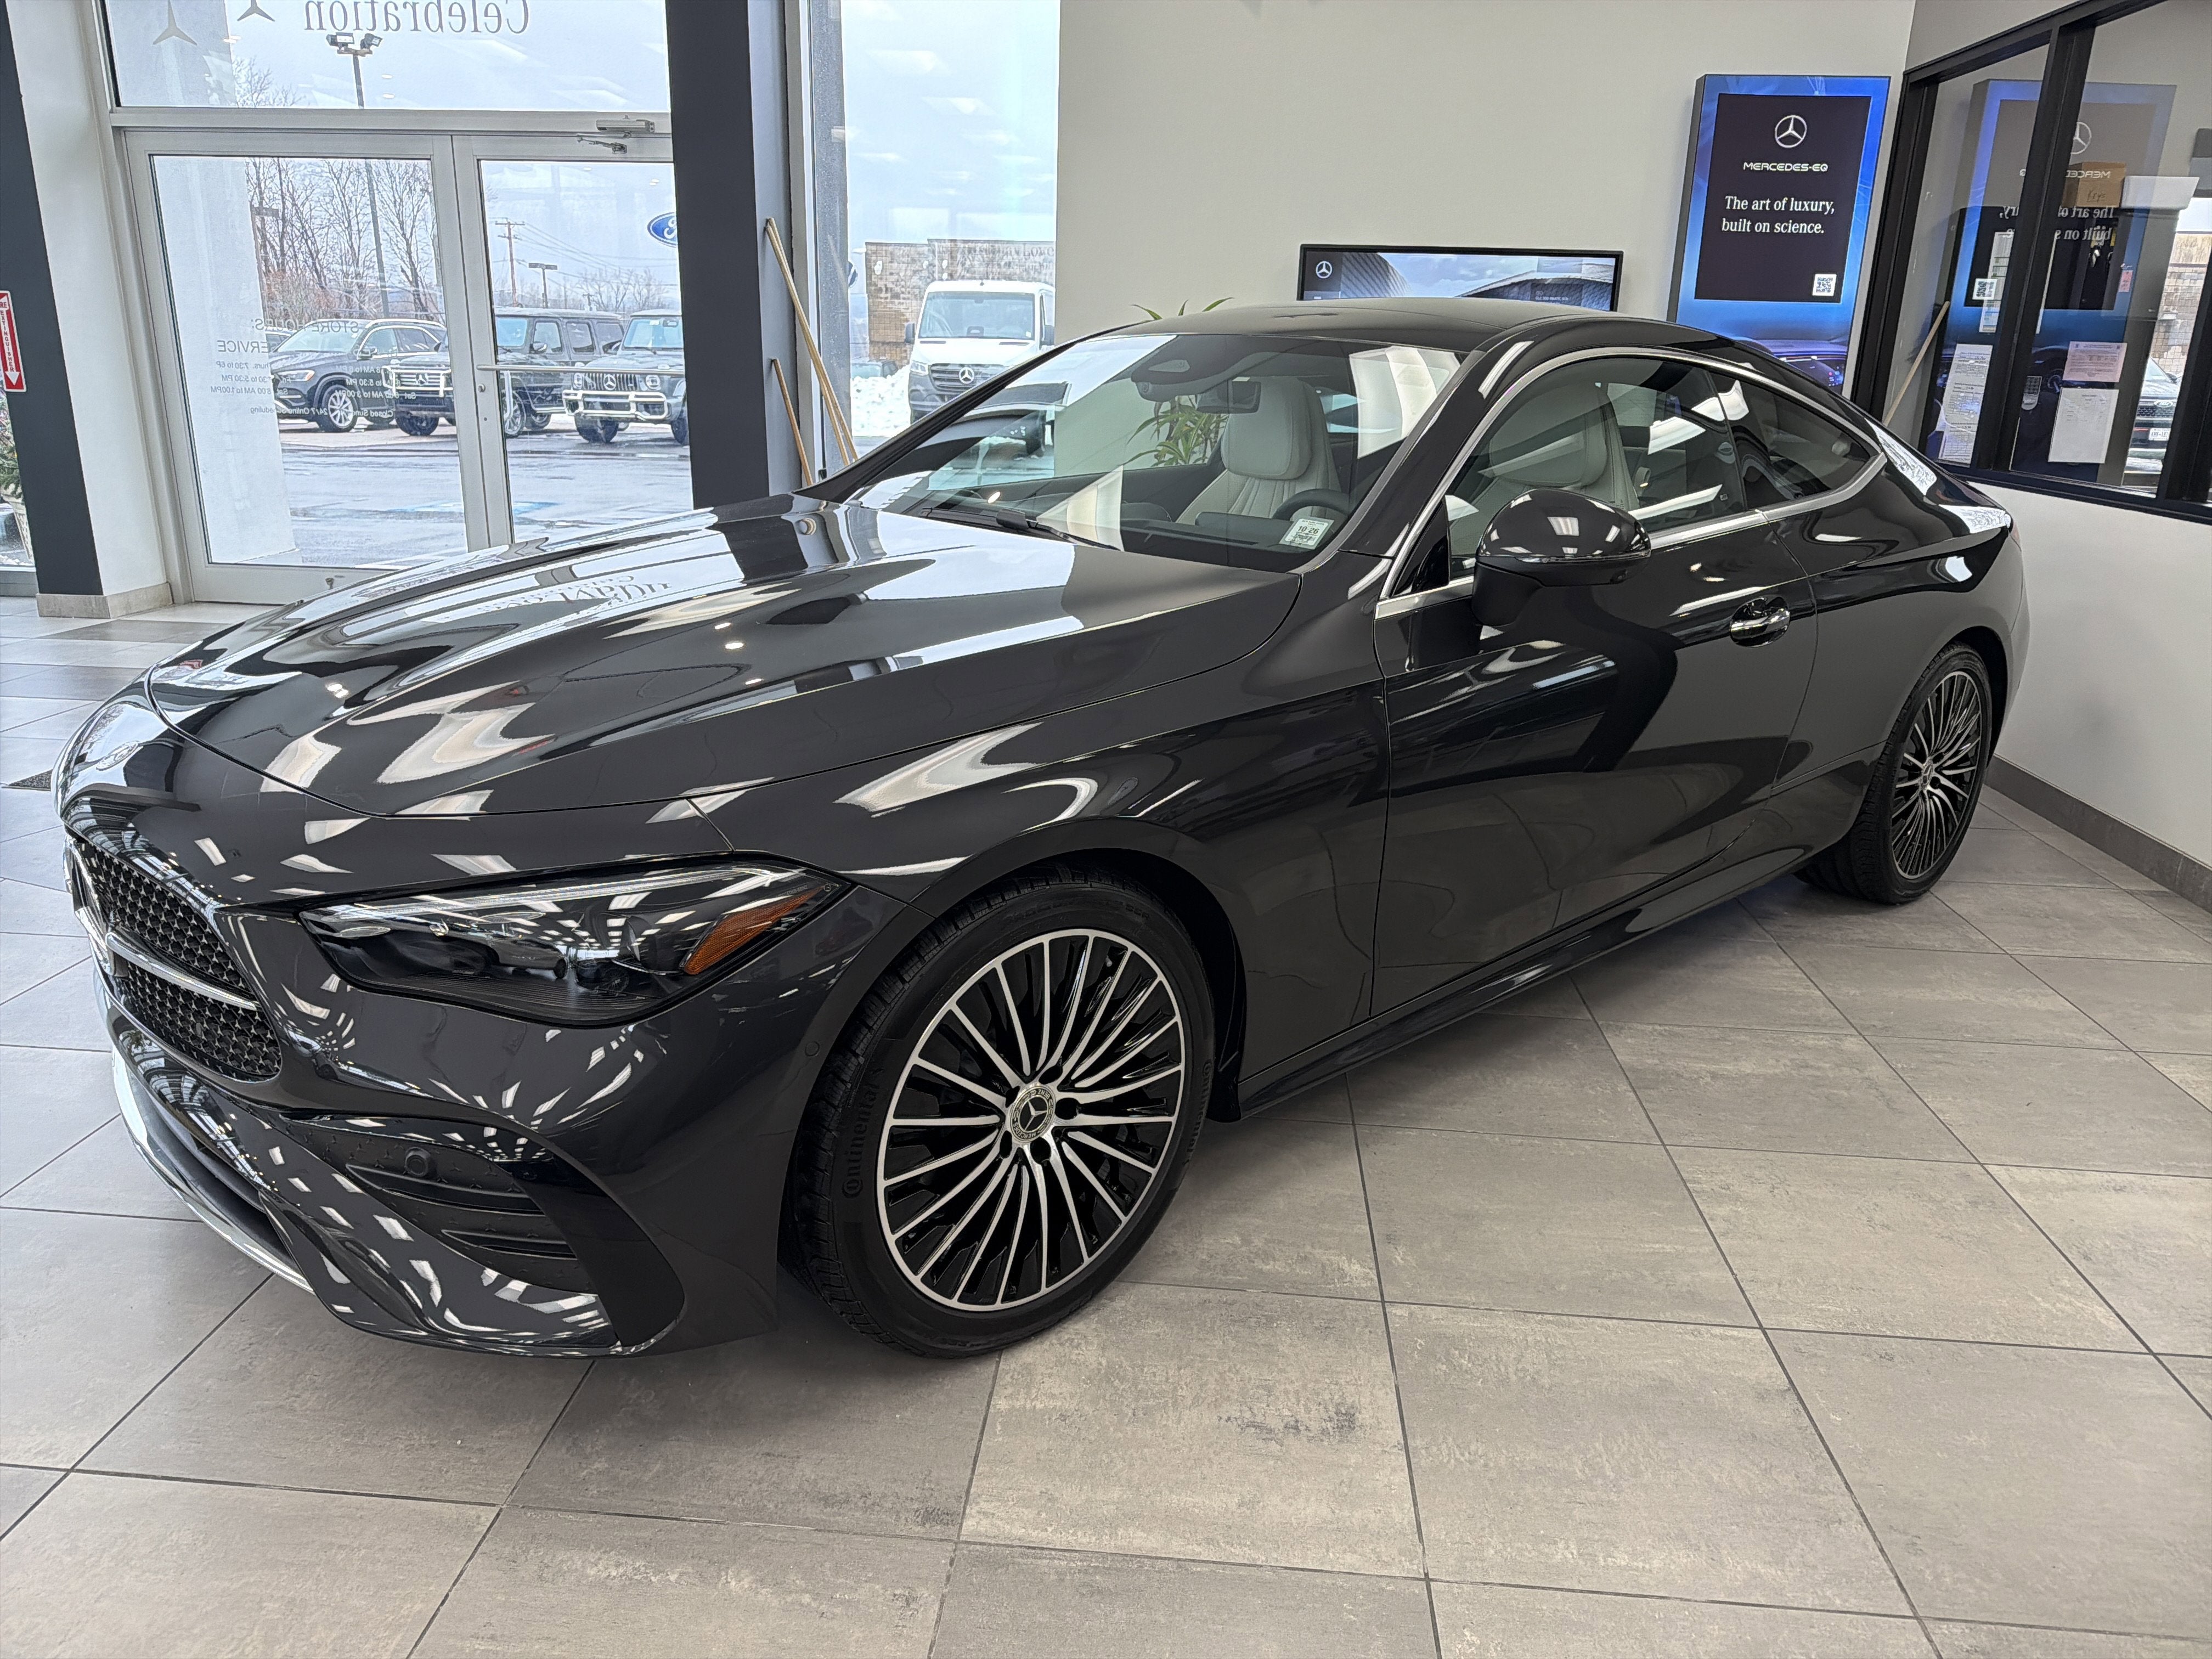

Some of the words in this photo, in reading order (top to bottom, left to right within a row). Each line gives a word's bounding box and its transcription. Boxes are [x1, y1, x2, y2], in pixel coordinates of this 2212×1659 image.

[1743, 162, 1829, 172] MERCEDES-EQ
[1725, 195, 1748, 210] The
[1752, 198, 1771, 211] art
[1774, 197, 1788, 211] of
[1790, 198, 1835, 215] luxury,
[1722, 218, 1752, 232] built
[1754, 222, 1770, 233] on
[1774, 220, 1824, 234] science.
[1, 310, 14, 372] EXTINGUISHER
[1038, 1089, 1051, 1099] BENZ
[1013, 1122, 1036, 1139] MERCEDES
